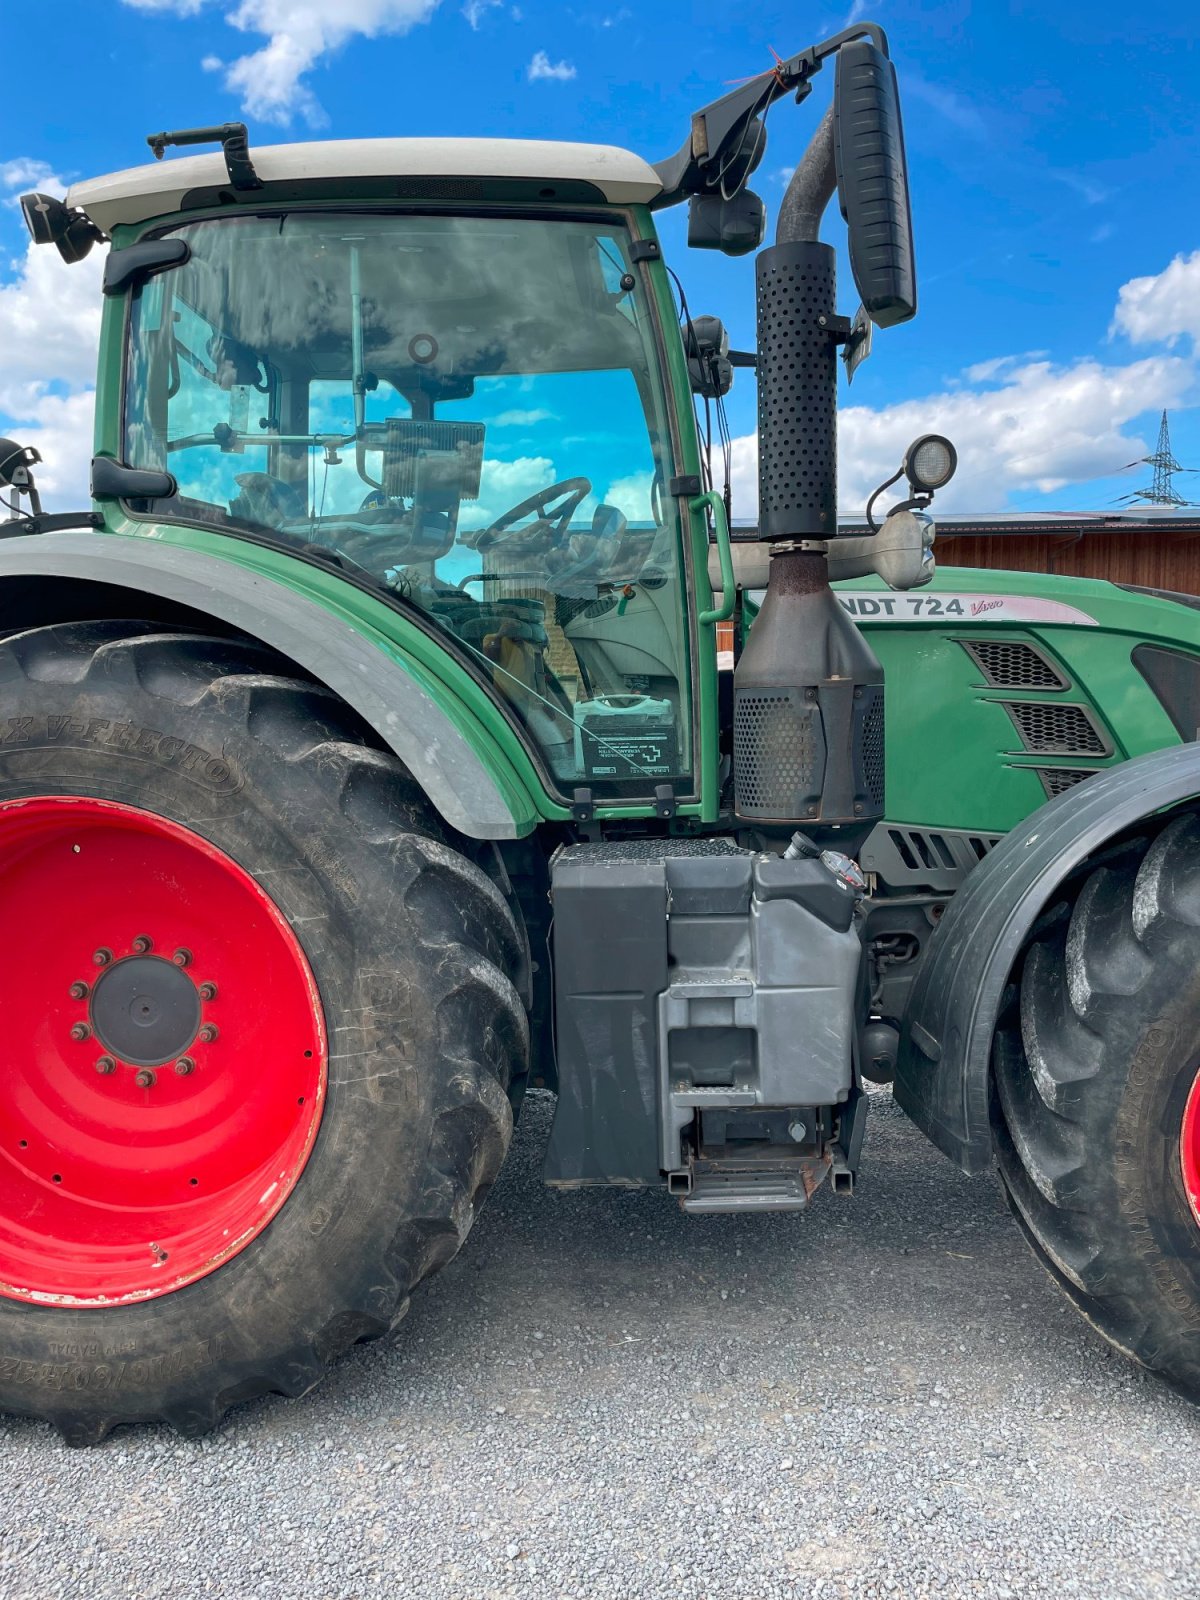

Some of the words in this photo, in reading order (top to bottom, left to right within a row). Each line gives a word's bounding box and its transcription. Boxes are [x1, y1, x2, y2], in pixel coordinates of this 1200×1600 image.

[838, 598, 896, 615] NDT
[907, 598, 965, 616] 724
[48, 1342, 98, 1356] RADIAL
